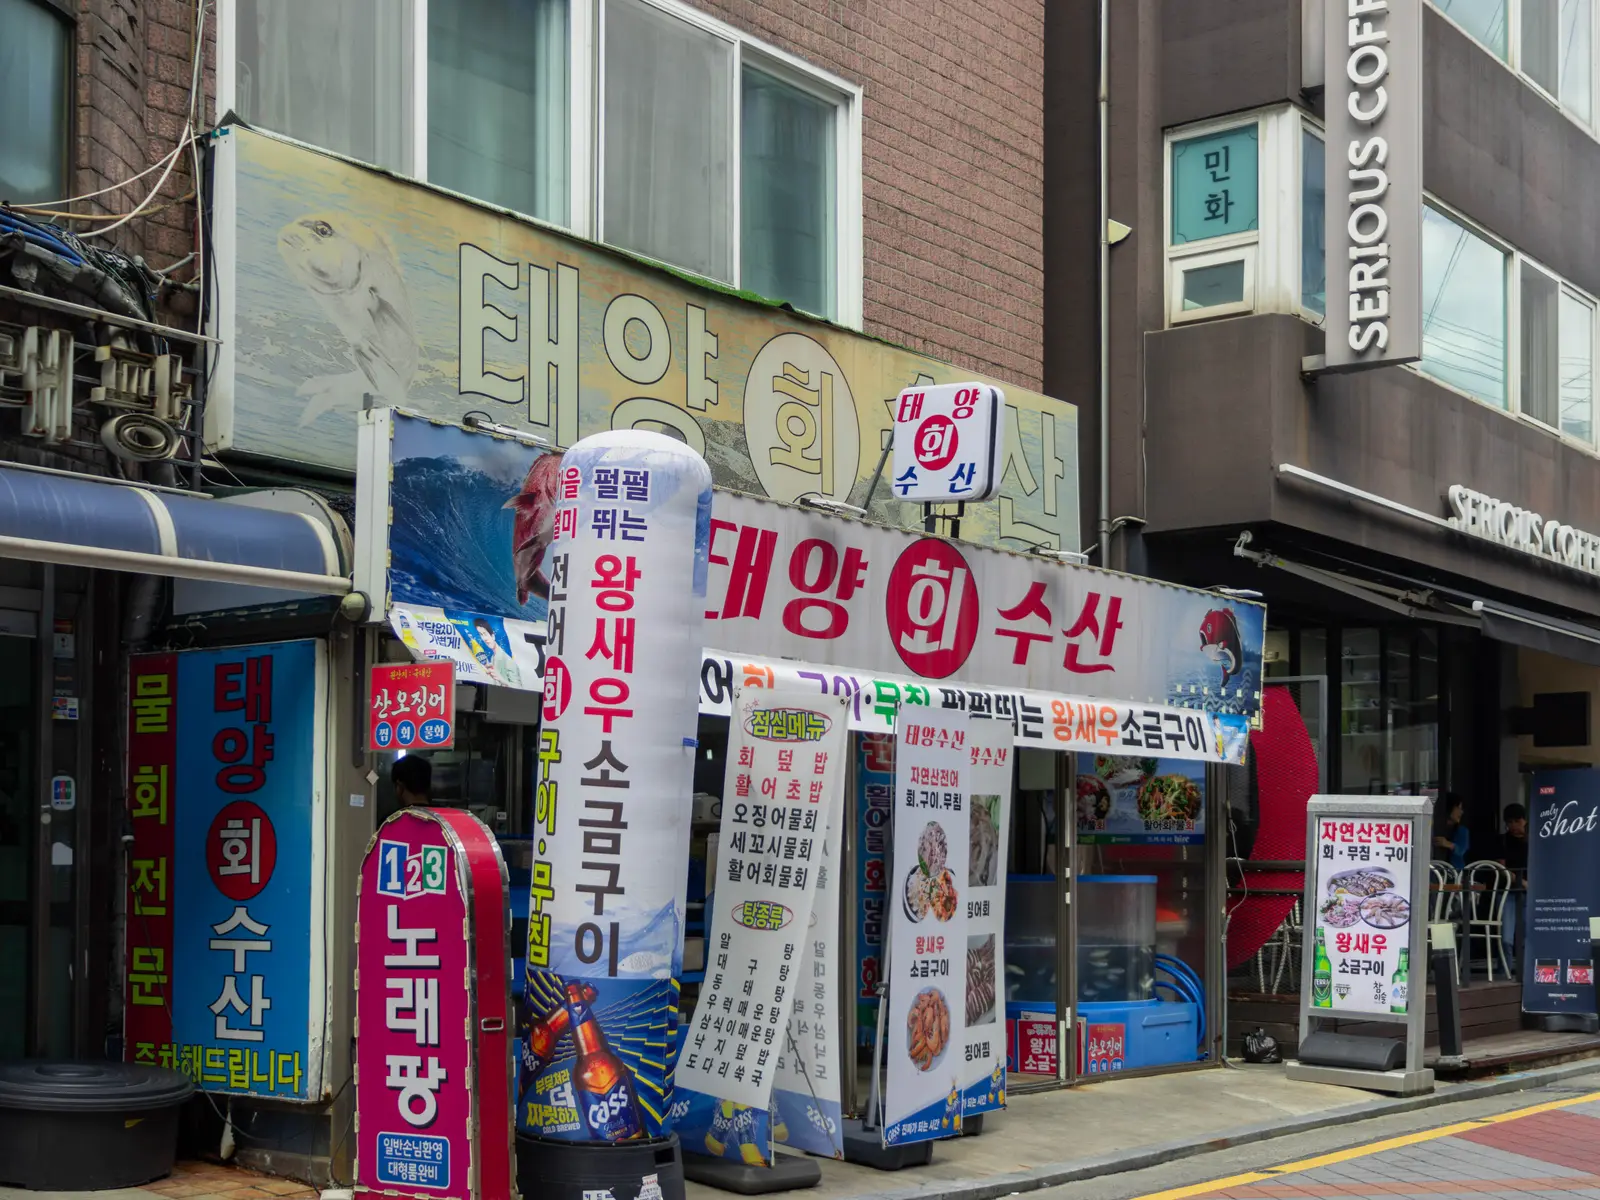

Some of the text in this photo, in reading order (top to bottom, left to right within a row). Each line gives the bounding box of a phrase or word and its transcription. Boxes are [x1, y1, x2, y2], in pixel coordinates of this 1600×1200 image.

[1204, 146, 1234, 225] 민화
[1348, 136, 1390, 354] SERIOUS
[918, 423, 954, 463] 회
[594, 468, 650, 502] 펄펄
[592, 508, 648, 542] 뛰는
[1449, 484, 1543, 555] SERIOUS
[548, 553, 569, 656] 전어
[704, 518, 1124, 673] 태양 회 수산
[373, 684, 446, 719] 산오징어
[400, 724, 411, 740] 회
[424, 724, 445, 739] 물회
[751, 709, 826, 741] 점심메뉴
[904, 724, 965, 751] 태양수산
[910, 766, 959, 788] 자연산전어
[1321, 820, 1410, 845] 자연산전어
[1539, 800, 1598, 838] shot
[207, 654, 275, 1042] 태양 회 수산
[1322, 844, 1335, 860] 회
[1384, 846, 1408, 863] 구이
[385, 847, 443, 892] 123
[915, 936, 945, 955] 왕새우
[1335, 931, 1388, 956] 왕새우
[909, 959, 950, 978] 소금구이
[1338, 959, 1385, 977] 소금구이
[384, 904, 447, 1126] 노래팡
[383, 1137, 443, 1160] 일반손님환영
[388, 1162, 438, 1183] 대형룸완비
